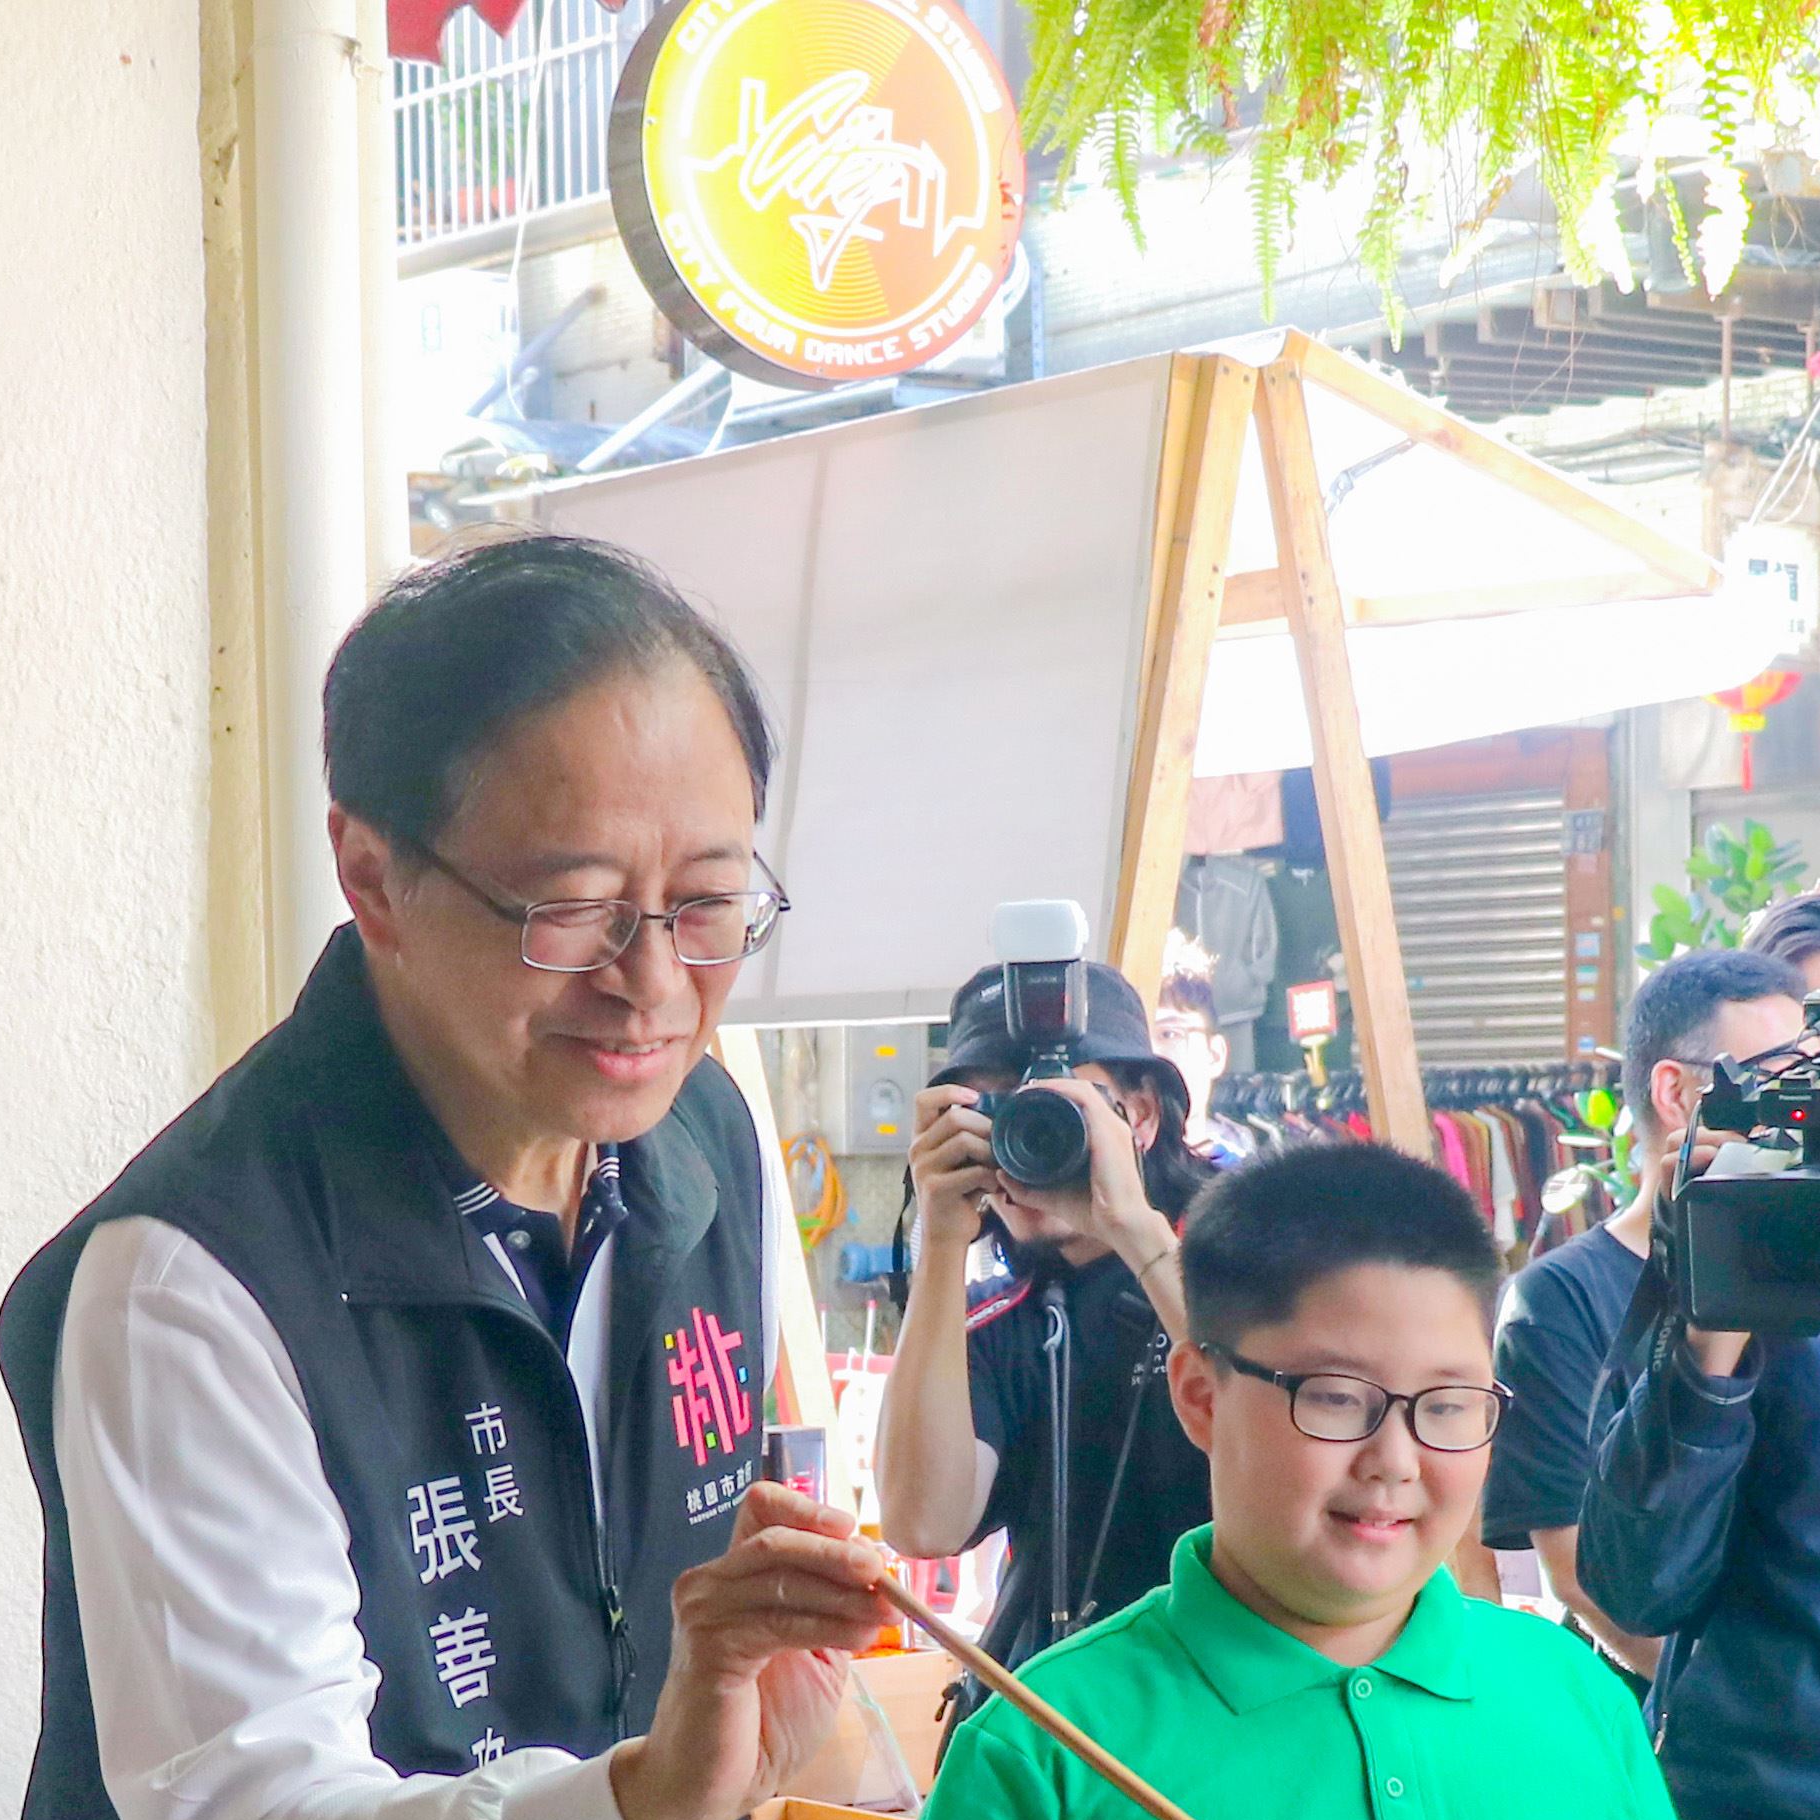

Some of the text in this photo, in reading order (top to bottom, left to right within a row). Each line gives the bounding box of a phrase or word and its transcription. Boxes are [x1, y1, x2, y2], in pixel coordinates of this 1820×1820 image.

[665, 212, 720, 285] CITY
[804, 336, 904, 366] DANCE
[908, 261, 994, 351] STUDIO
[464, 1401, 524, 1524] 市長
